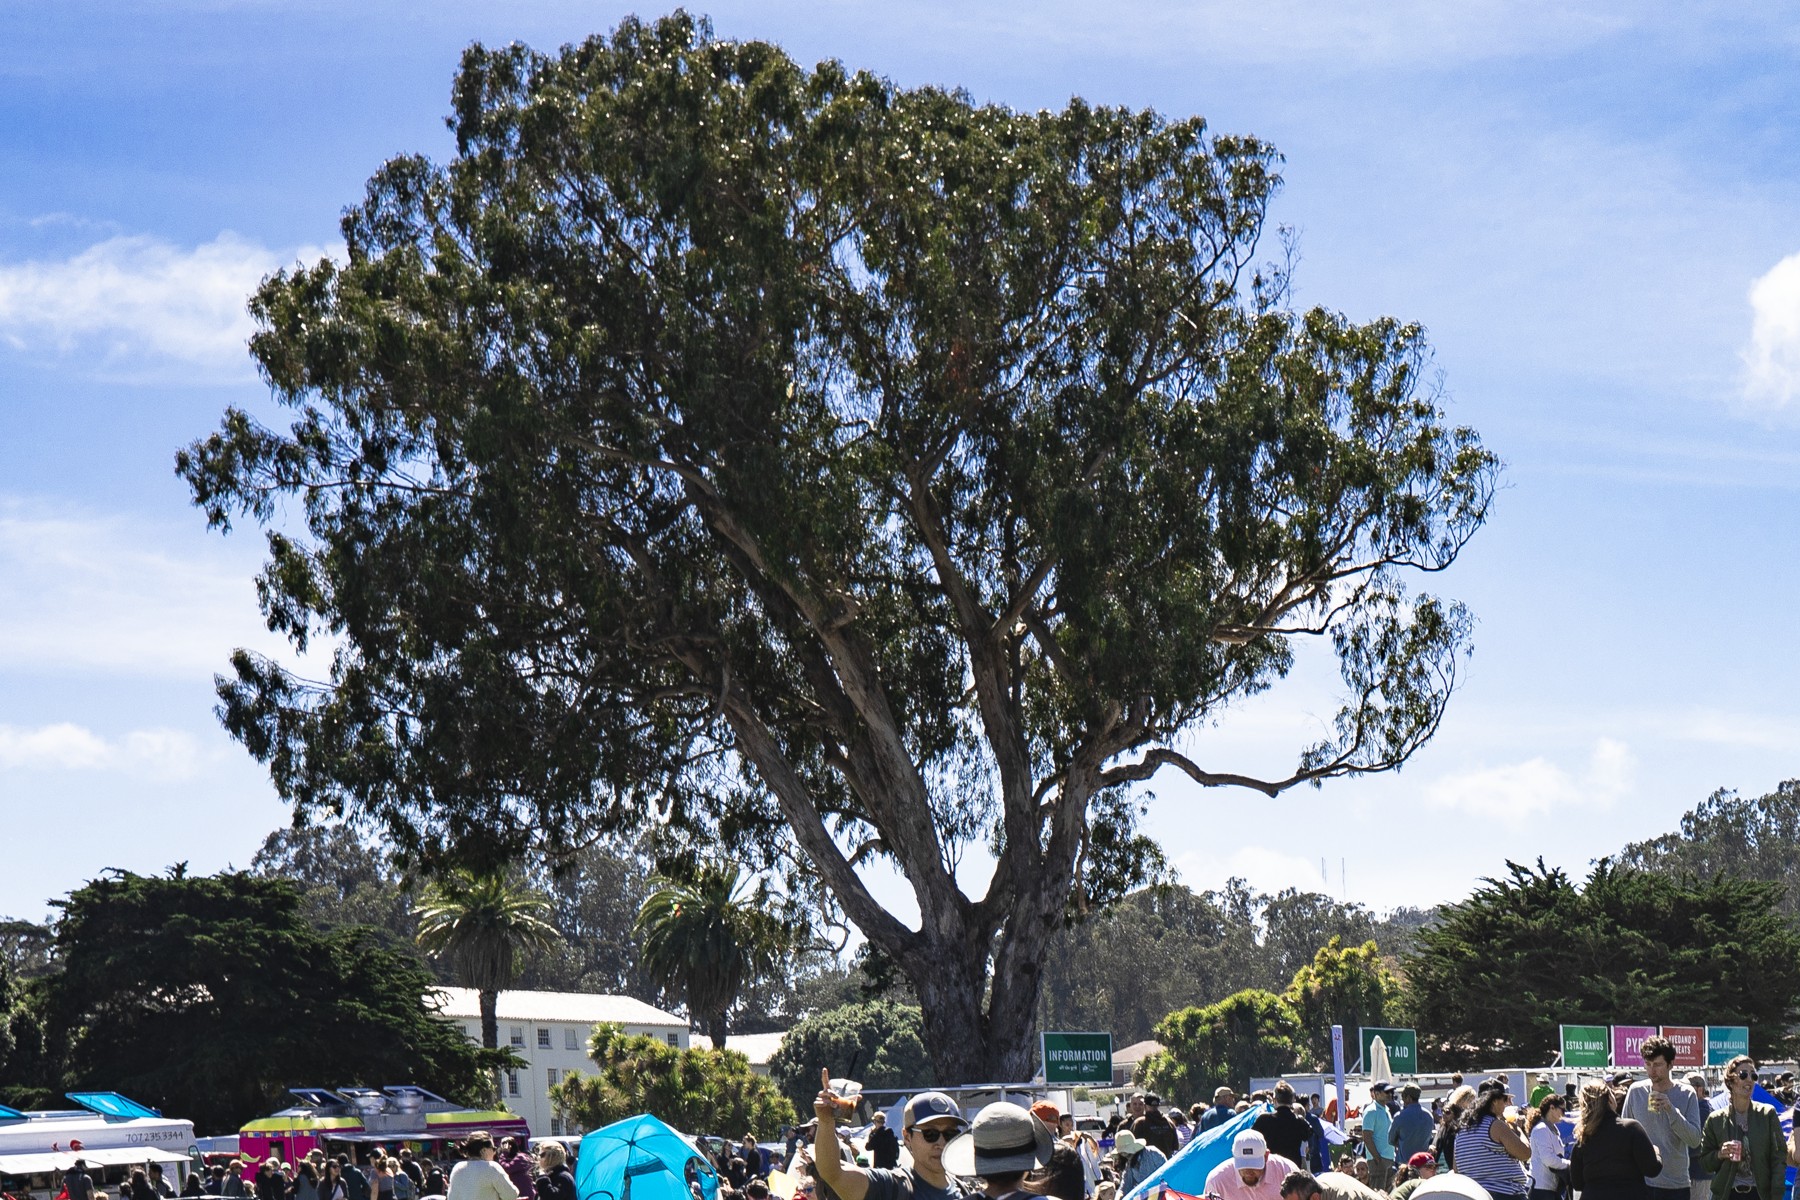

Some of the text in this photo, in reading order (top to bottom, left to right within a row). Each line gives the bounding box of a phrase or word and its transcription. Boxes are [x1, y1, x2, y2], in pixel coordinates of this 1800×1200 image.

[1565, 1040, 1604, 1051] ESTAS MANOS
[1709, 1041, 1722, 1049] OCEAN
[1048, 1049, 1107, 1062] INFORMATION
[1394, 1045, 1409, 1058] AID
